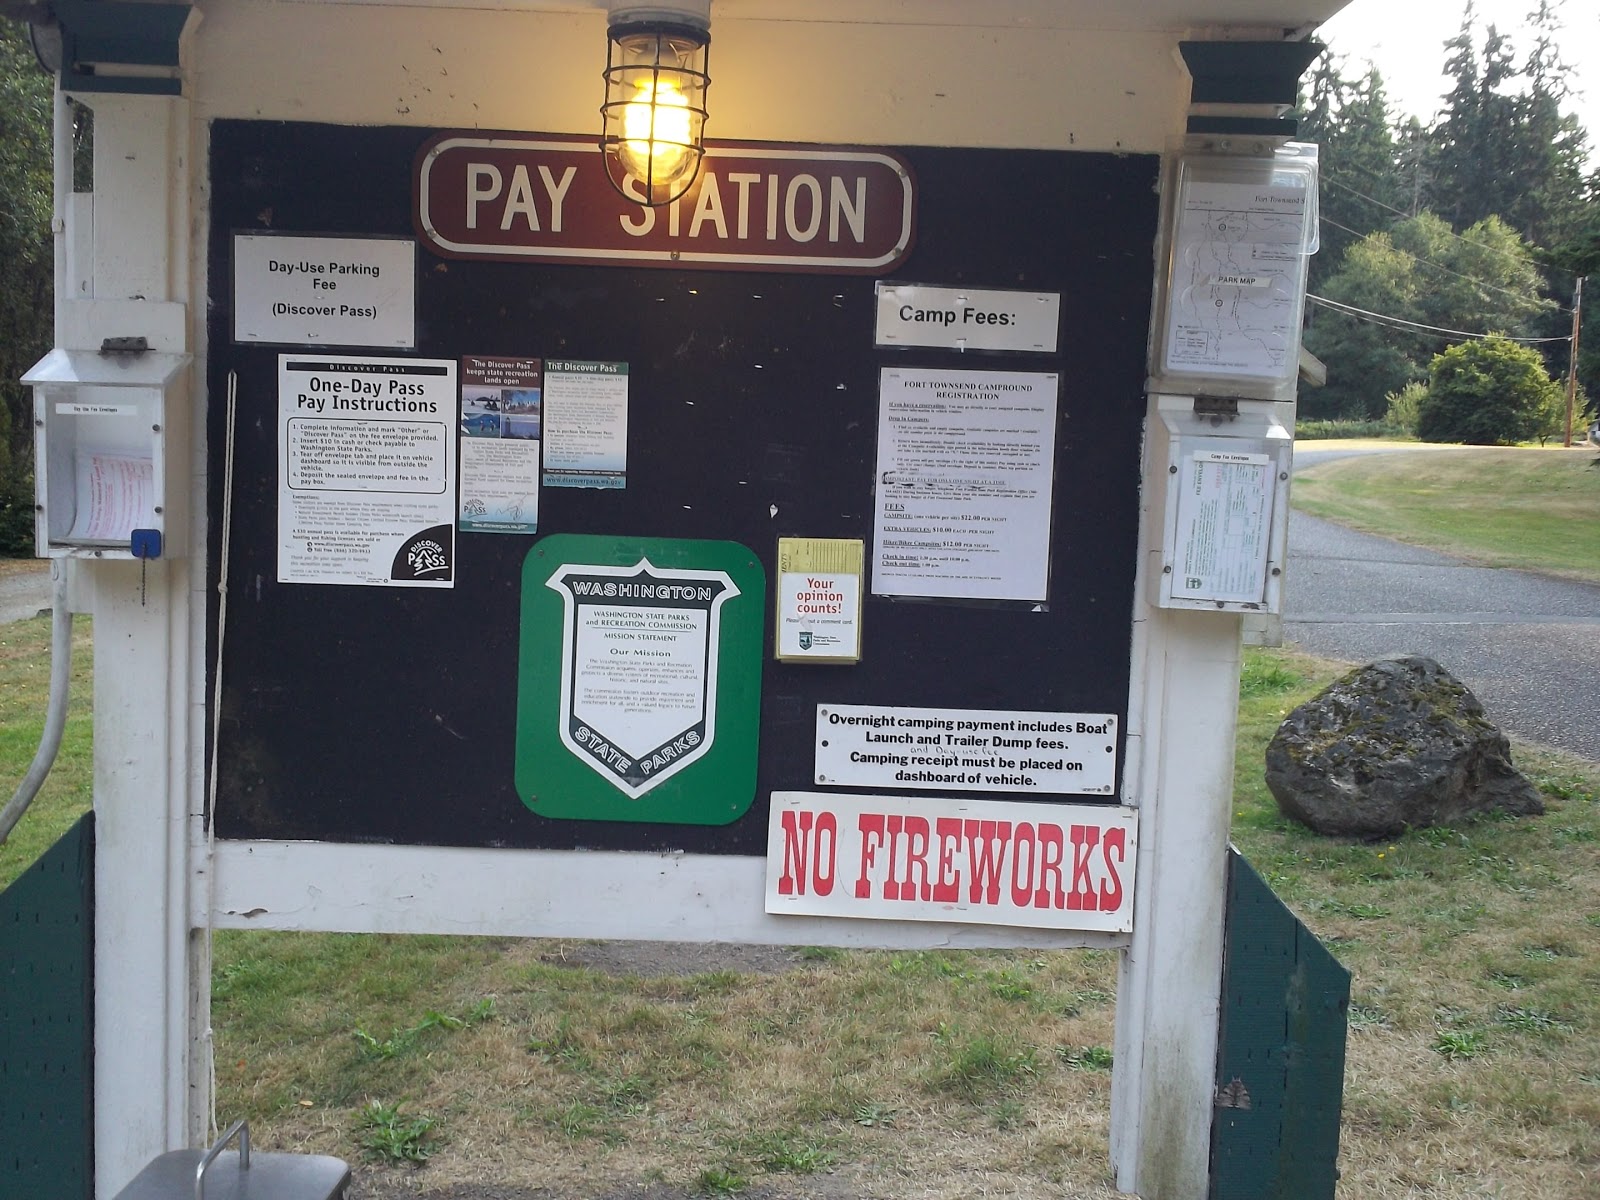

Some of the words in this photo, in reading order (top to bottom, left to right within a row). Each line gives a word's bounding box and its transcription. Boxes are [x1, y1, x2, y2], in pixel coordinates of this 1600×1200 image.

[466, 164, 578, 232] PAY
[619, 172, 866, 243] STATION
[269, 261, 325, 277] Day-Use
[330, 263, 379, 277] Parking
[313, 279, 336, 289] Fee
[272, 302, 336, 317] (Discover
[340, 304, 377, 318] Pass)
[899, 305, 956, 327] Camp
[964, 308, 1016, 326] Fees:
[548, 362, 562, 370] The
[565, 363, 597, 371] Discover
[600, 364, 617, 372] Pass
[310, 377, 382, 397] One-Day
[389, 380, 424, 395] Pass
[298, 394, 325, 412] Pay
[333, 396, 437, 412] Instructions
[300, 424, 328, 432] Complete
[411, 540, 443, 554] DISCOVER
[573, 582, 712, 600] WASHINGTON
[808, 578, 834, 588] Your
[797, 590, 843, 602] opinion
[797, 603, 841, 614] counts!
[829, 714, 895, 727] Overnight
[898, 719, 954, 730] camping
[957, 722, 1015, 730] payment
[1018, 721, 1072, 732] includes
[1076, 723, 1108, 734] Boat
[866, 732, 913, 743] Launch
[917, 735, 940, 746] and
[945, 735, 989, 746] Trailer
[993, 736, 1032, 748] Dump
[1036, 738, 1068, 749] fees.
[575, 726, 632, 773] STATE
[640, 731, 700, 775] PARKS
[850, 752, 908, 766] Camping
[912, 756, 958, 766] receipt
[962, 759, 995, 767] must
[999, 757, 1015, 768] be
[1020, 759, 1063, 769] placed
[895, 771, 965, 782] dashboard
[968, 773, 981, 783] of
[986, 774, 1036, 785] vehicle.
[778, 811, 837, 896] NO
[855, 813, 1126, 911] FIREWORKS
